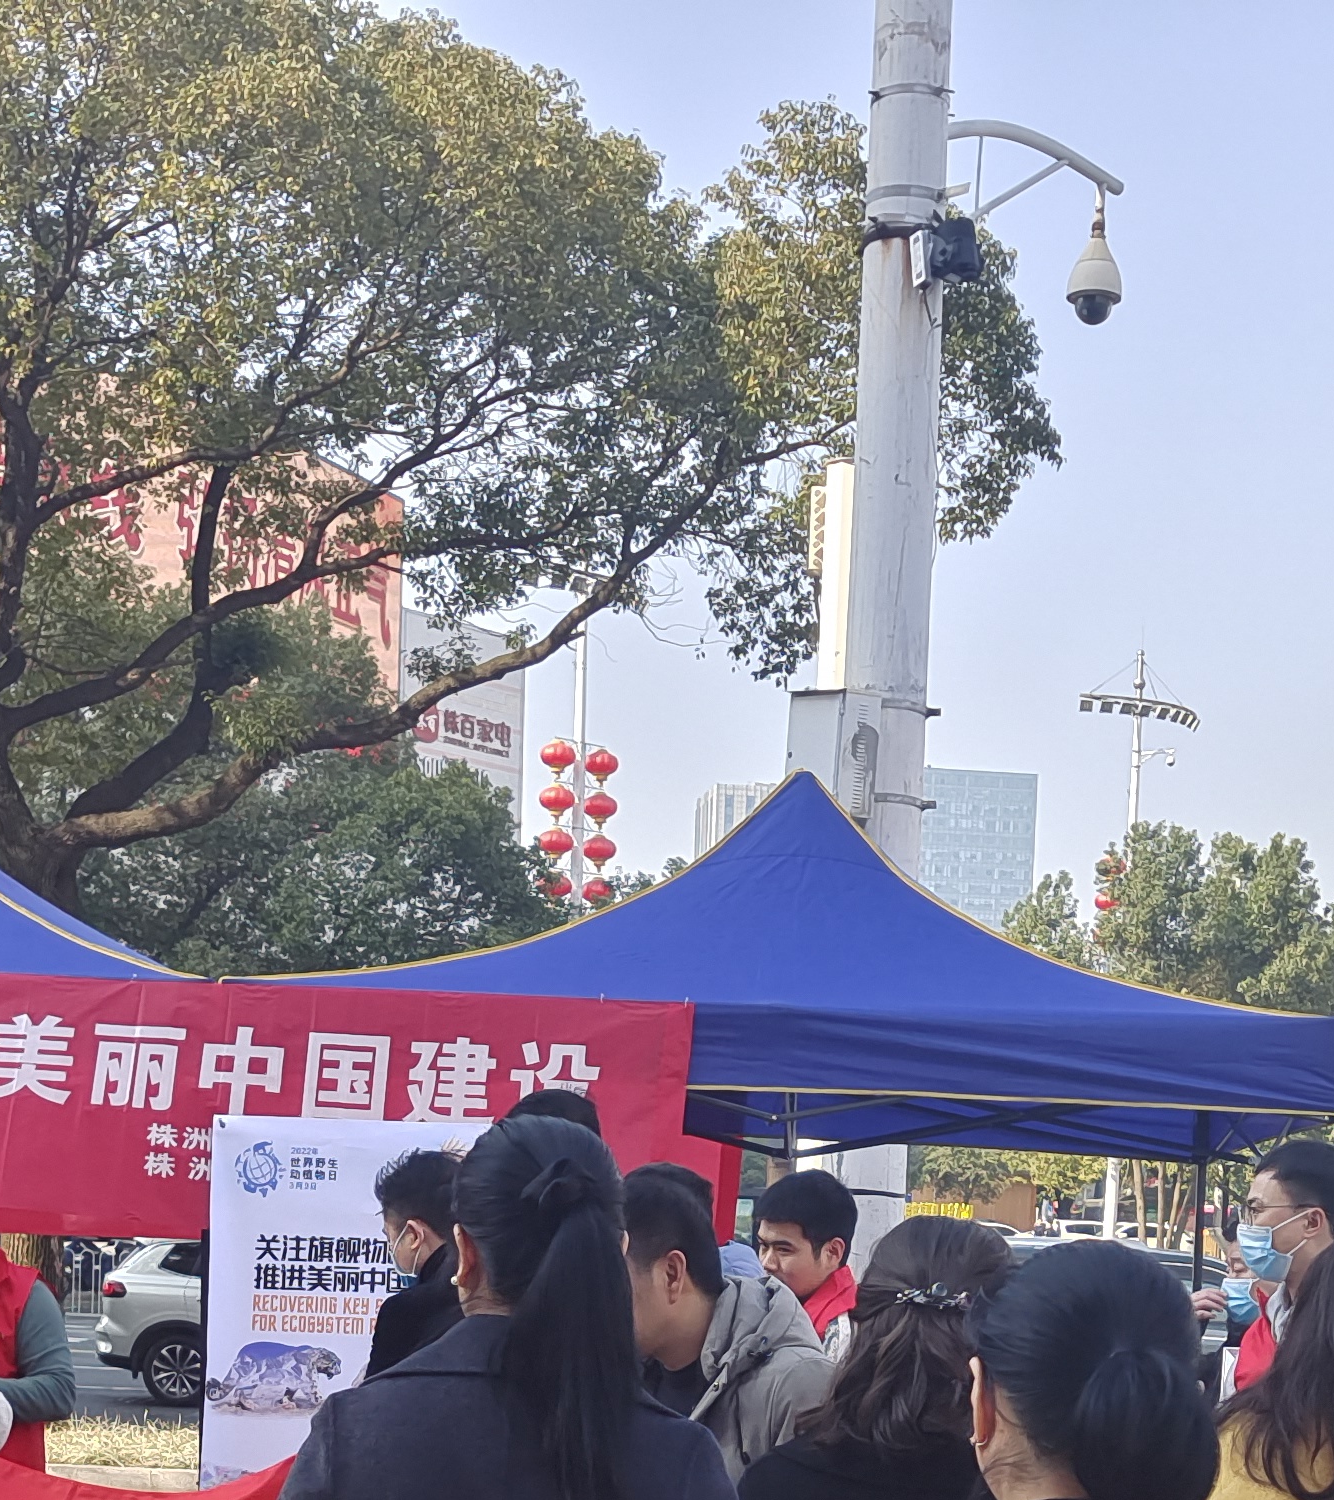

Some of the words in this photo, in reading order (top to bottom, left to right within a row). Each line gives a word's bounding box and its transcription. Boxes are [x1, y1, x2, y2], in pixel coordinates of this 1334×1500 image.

[146, 1123, 212, 1152] 株洲
[290, 1156, 339, 1169] 世界野生
[255, 1234, 393, 1264] 关注旗舰物
[252, 1294, 338, 1315] RECOVERING
[342, 1297, 371, 1315] KEY
[251, 1314, 277, 1332] FOR
